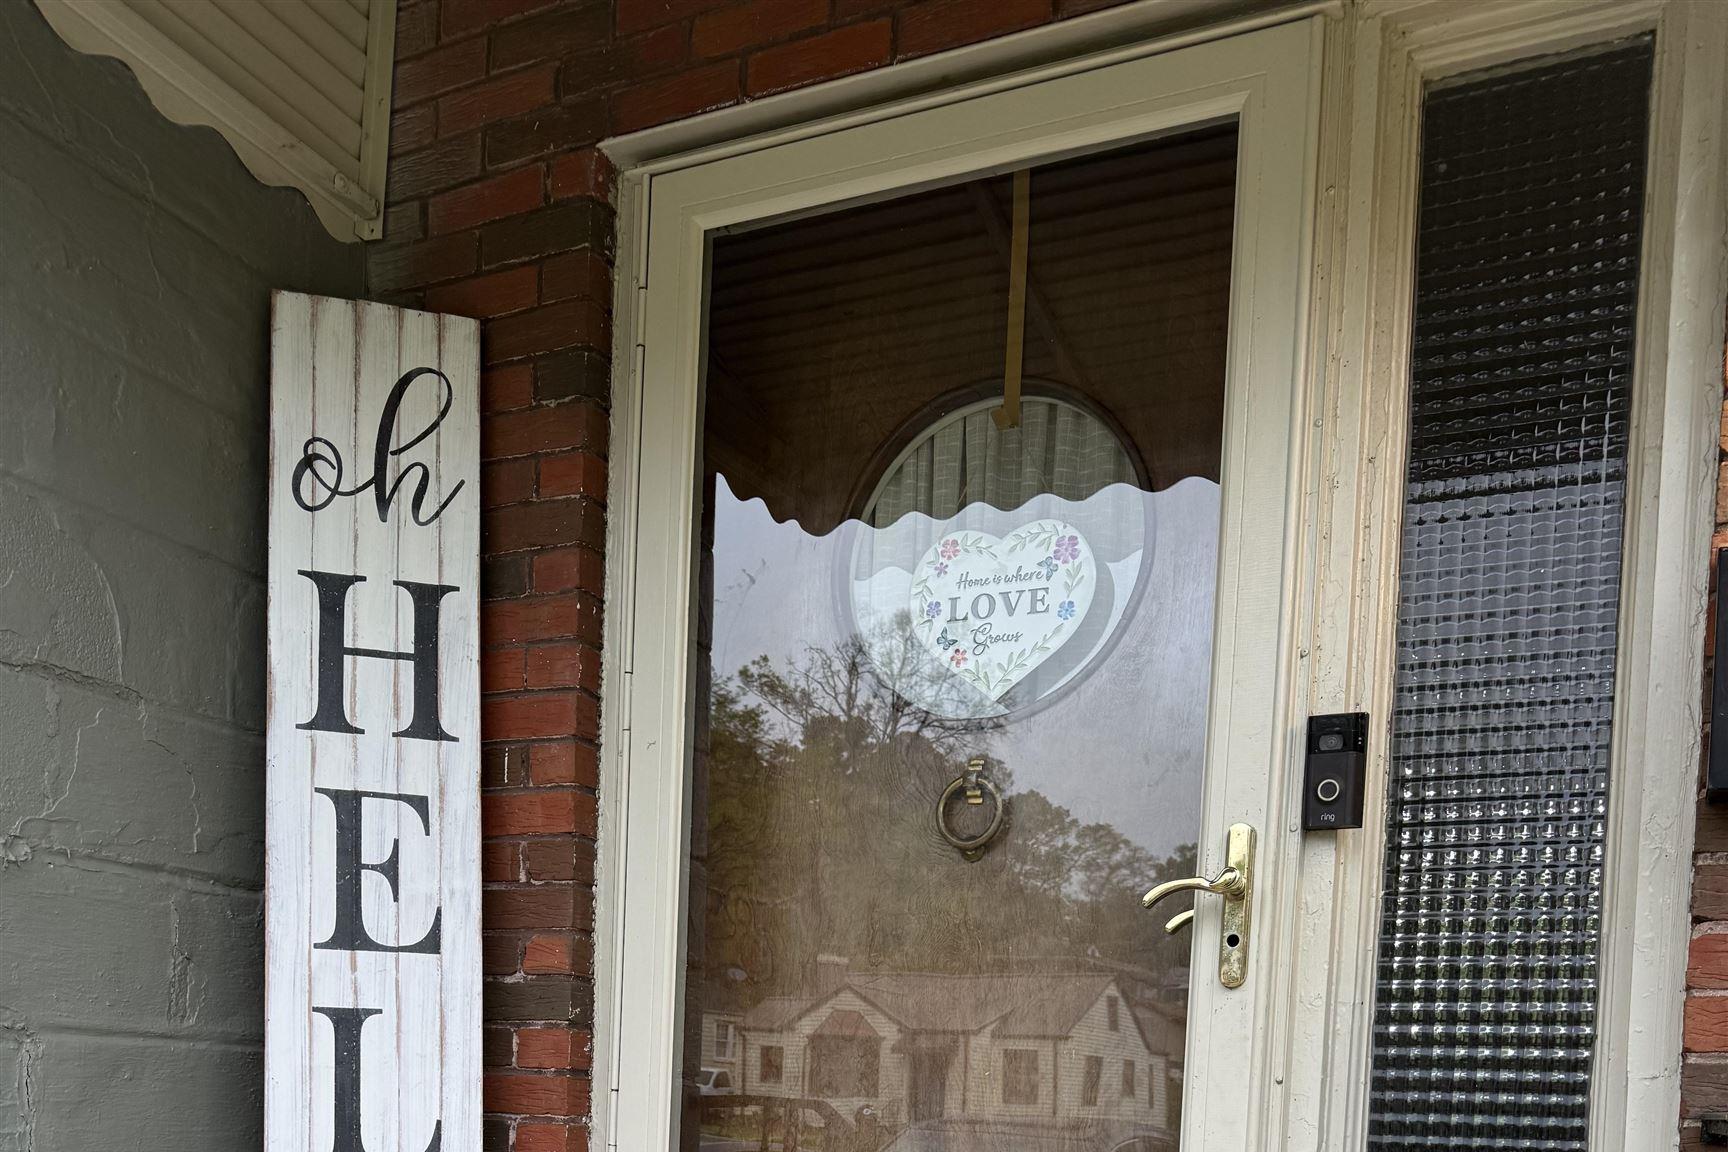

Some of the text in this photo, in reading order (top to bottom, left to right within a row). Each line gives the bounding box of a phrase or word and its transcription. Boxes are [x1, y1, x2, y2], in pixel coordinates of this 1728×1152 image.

[292, 366, 466, 527] oh
[957, 565, 1044, 589] Home is where
[946, 587, 1051, 623] LOVE
[970, 622, 1023, 656] Grows
[1320, 812, 1335, 821] ring
